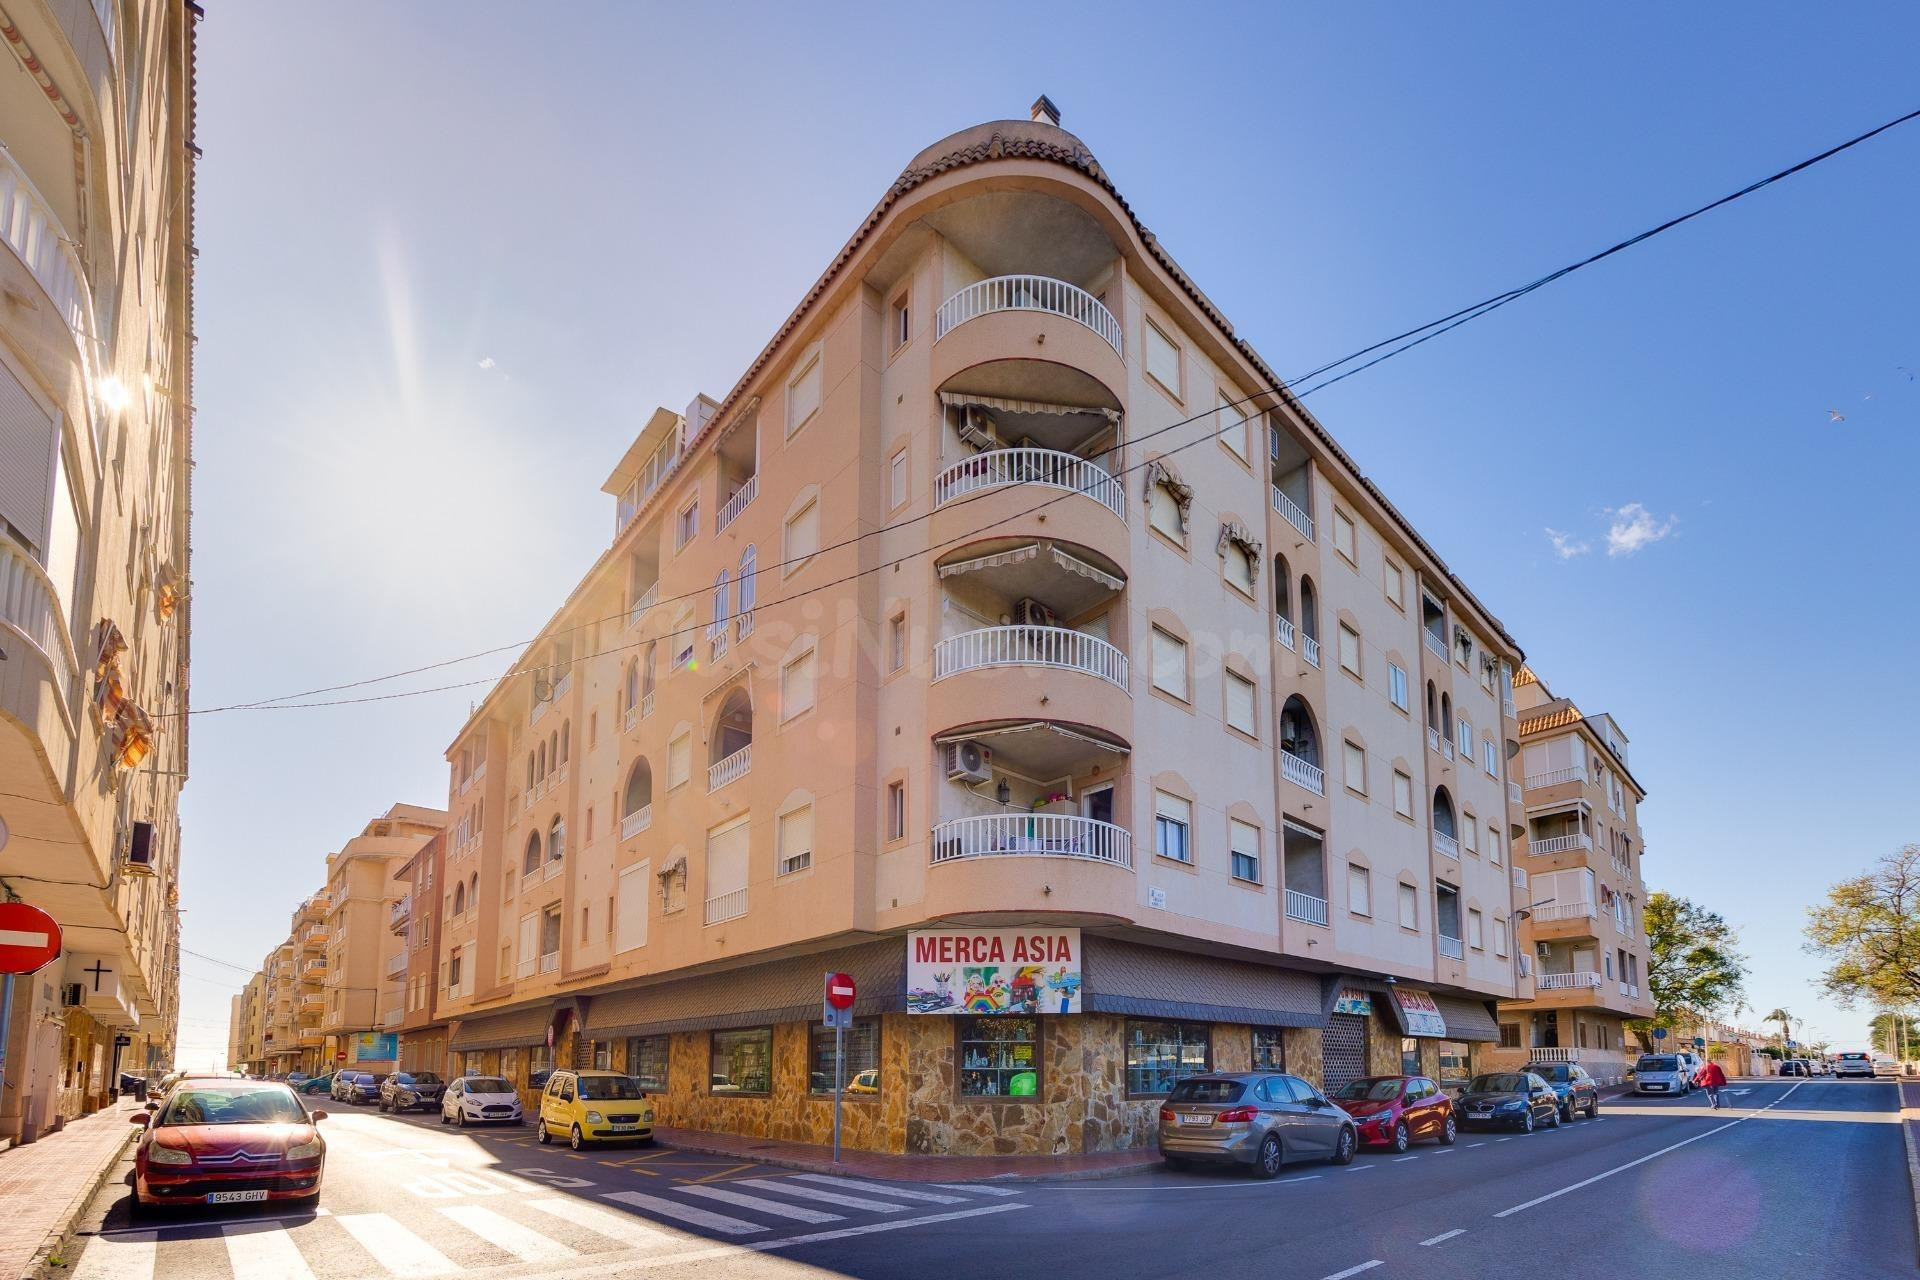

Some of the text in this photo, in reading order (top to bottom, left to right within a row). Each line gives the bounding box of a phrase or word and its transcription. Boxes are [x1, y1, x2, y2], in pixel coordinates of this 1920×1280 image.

[915, 935, 1072, 963] MERCA ASIA
[215, 1191, 265, 1202] 9543 GHV
